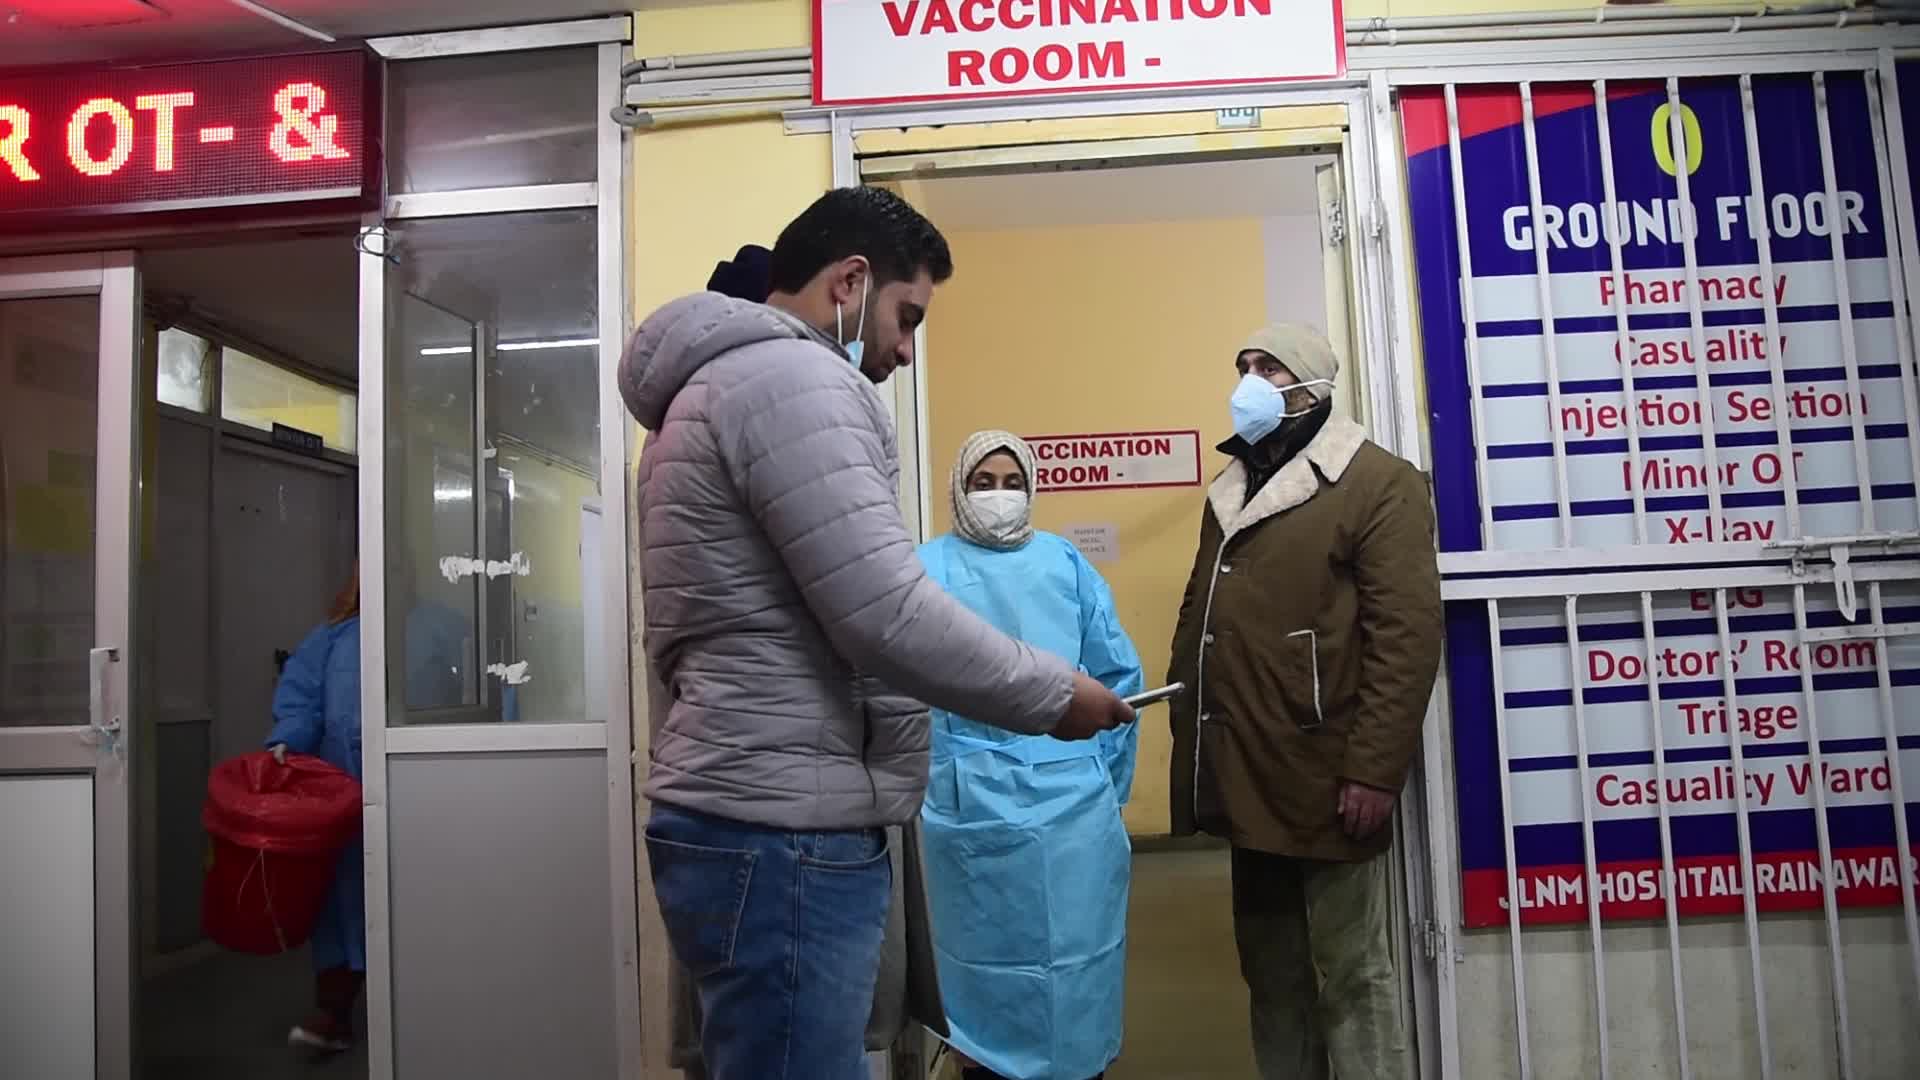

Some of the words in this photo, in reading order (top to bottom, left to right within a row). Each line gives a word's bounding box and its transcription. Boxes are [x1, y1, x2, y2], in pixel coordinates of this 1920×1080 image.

[947, 40, 1126, 87] ROOM
[269, 82, 350, 162] &
[1502, 198, 1698, 251] GROUND
[1715, 190, 1869, 241] FLOOR
[1599, 273, 1787, 306] Pharmacy
[1727, 386, 1868, 422] Setion
[1029, 438, 1171, 461] CCINATION
[1036, 465, 1109, 485] ROOM
[1623, 457, 1740, 491] Minor
[1690, 588, 1765, 611] EG
[1763, 639, 1877, 672] Room
[1678, 700, 1798, 740] Triage
[1595, 766, 1775, 806] Casuality
[1785, 756, 1892, 795] Ward
[1595, 865, 1745, 903] HOSPITAL
